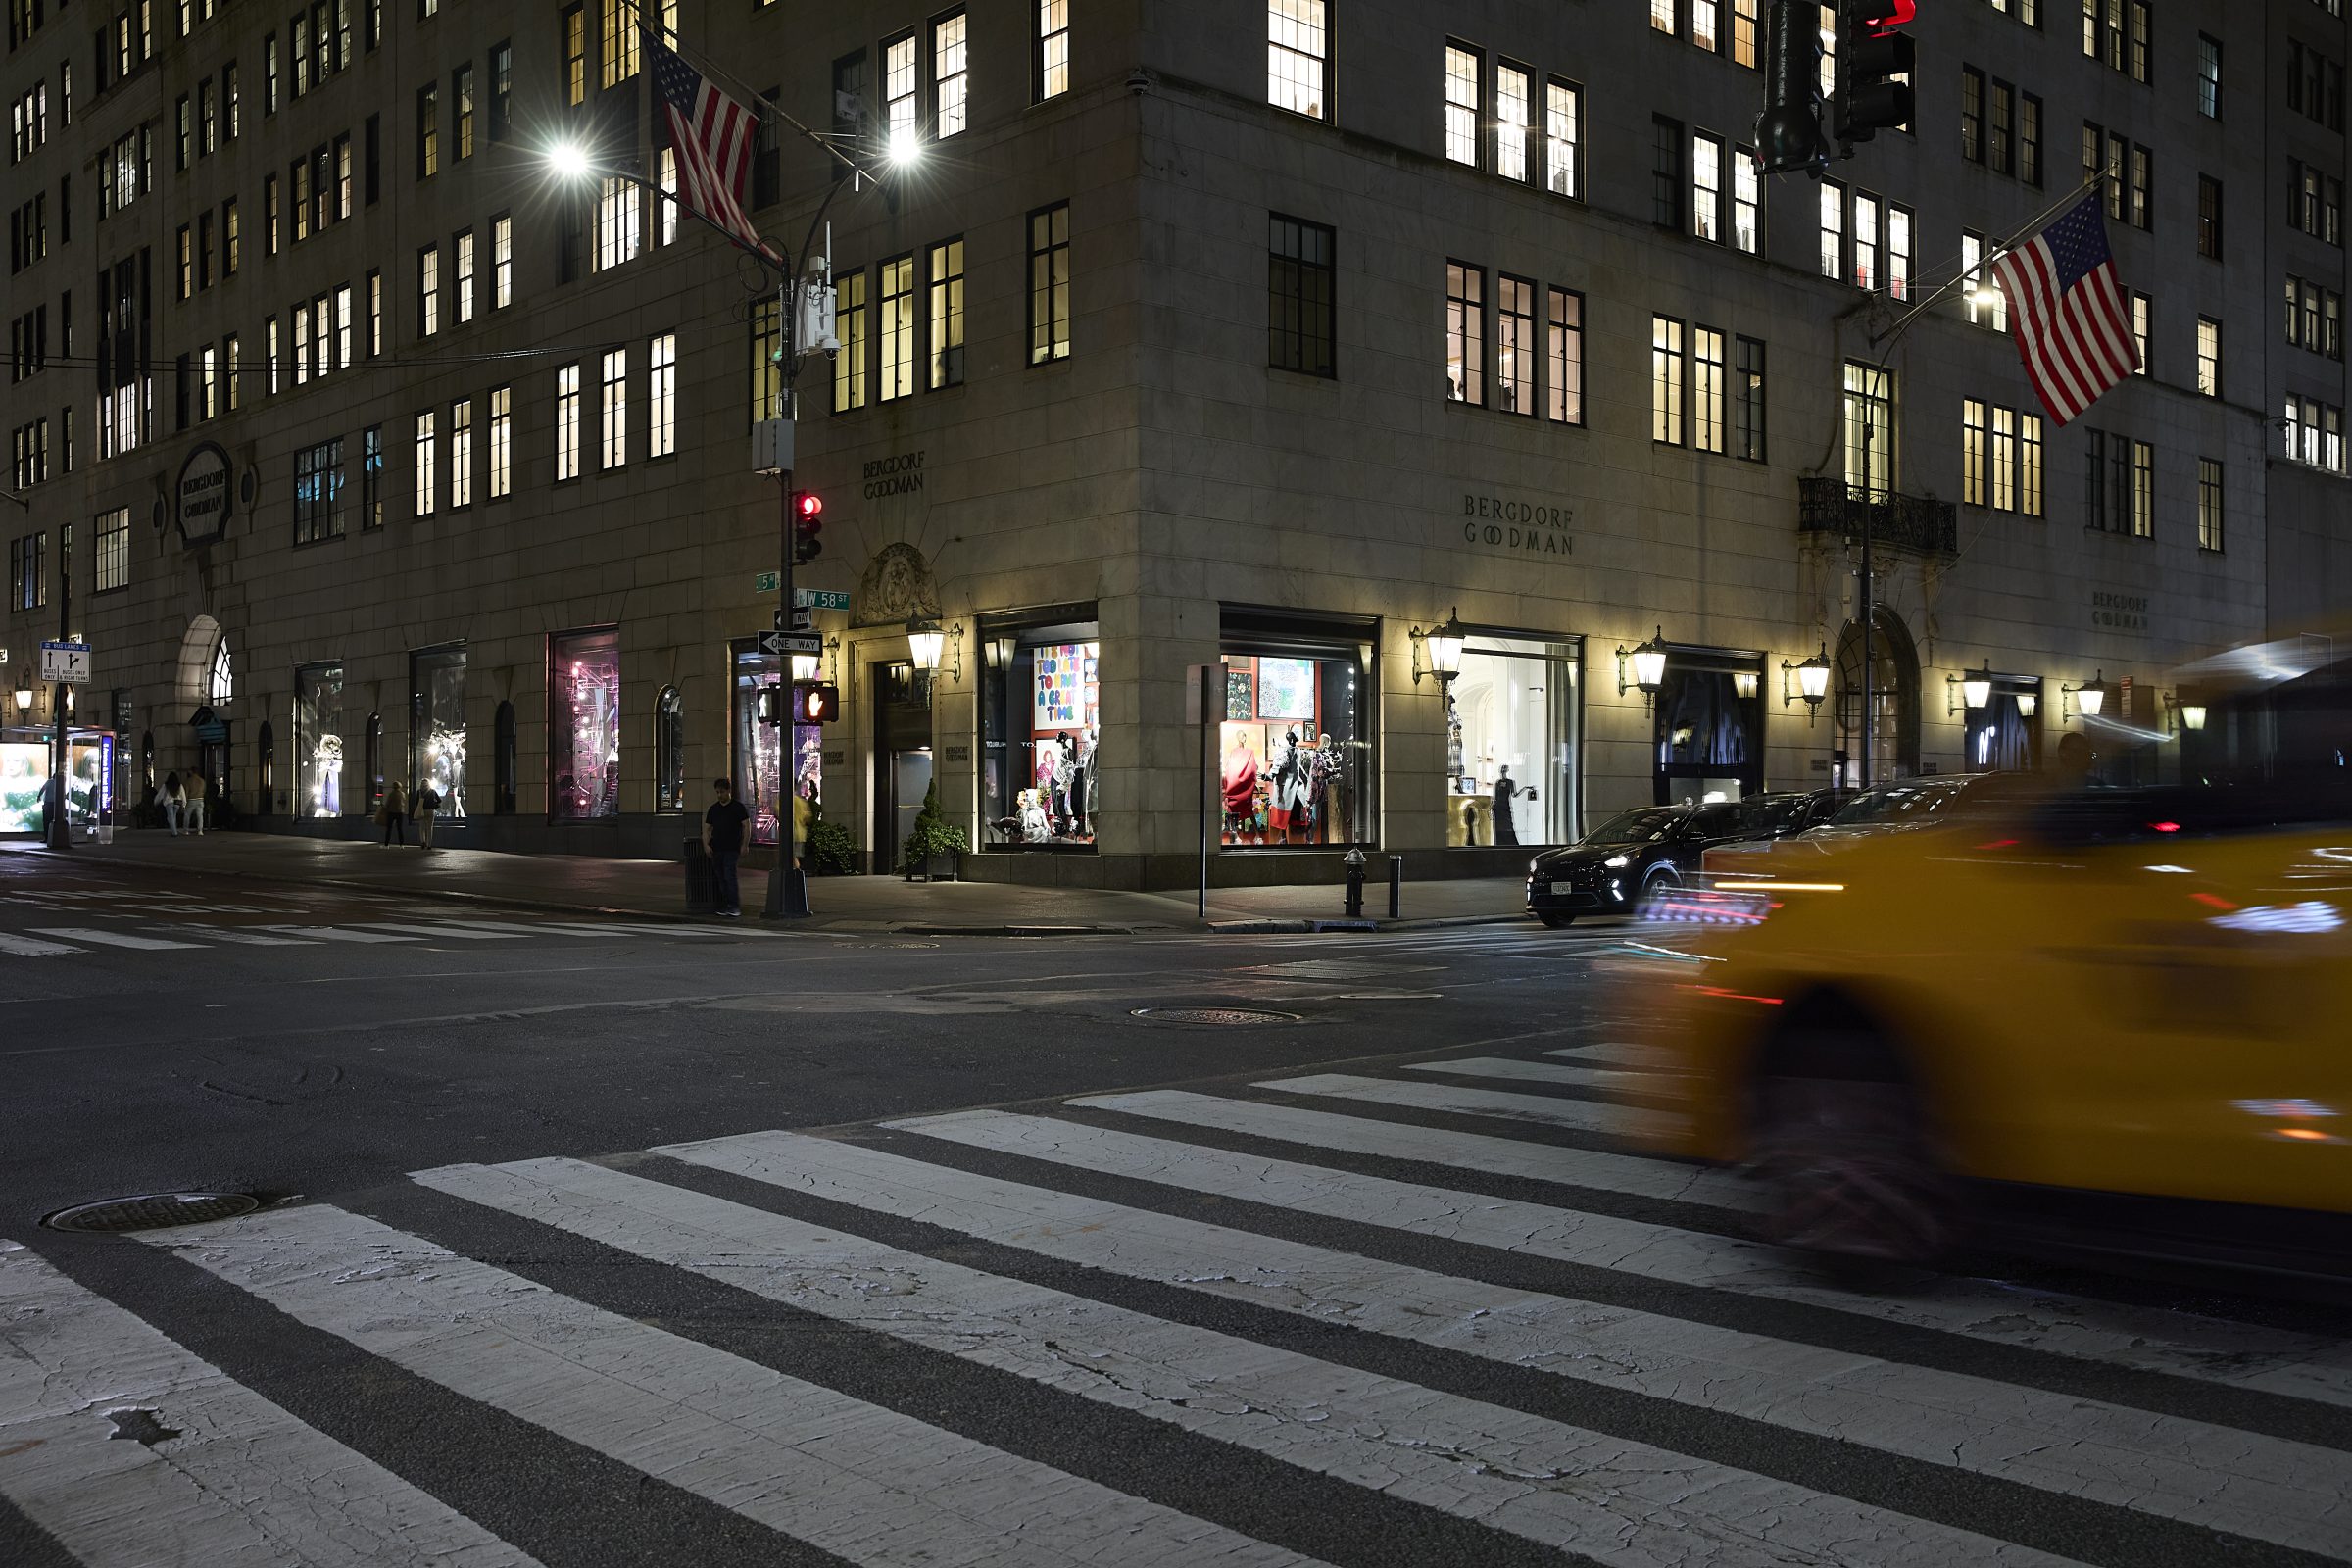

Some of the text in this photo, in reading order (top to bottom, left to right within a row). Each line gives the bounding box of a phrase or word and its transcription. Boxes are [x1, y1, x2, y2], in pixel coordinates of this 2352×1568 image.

[864, 450, 925, 479] BERGDORF
[183, 469, 226, 496] BERGDORF
[864, 472, 923, 500] GOODMAN
[1464, 494, 1573, 529] BERGDORF
[1464, 522, 1573, 556] GOODMAN
[762, 575, 768, 589] 5
[807, 591, 848, 608] W 58 ST
[797, 612, 808, 623] WAY
[771, 638, 816, 650] ONE WAY
[1036, 657, 1081, 675] TOO LATE
[1038, 673, 1077, 690] TO HAVE
[1038, 689, 1076, 707] A GREAT
[1047, 705, 1074, 722] TIME
